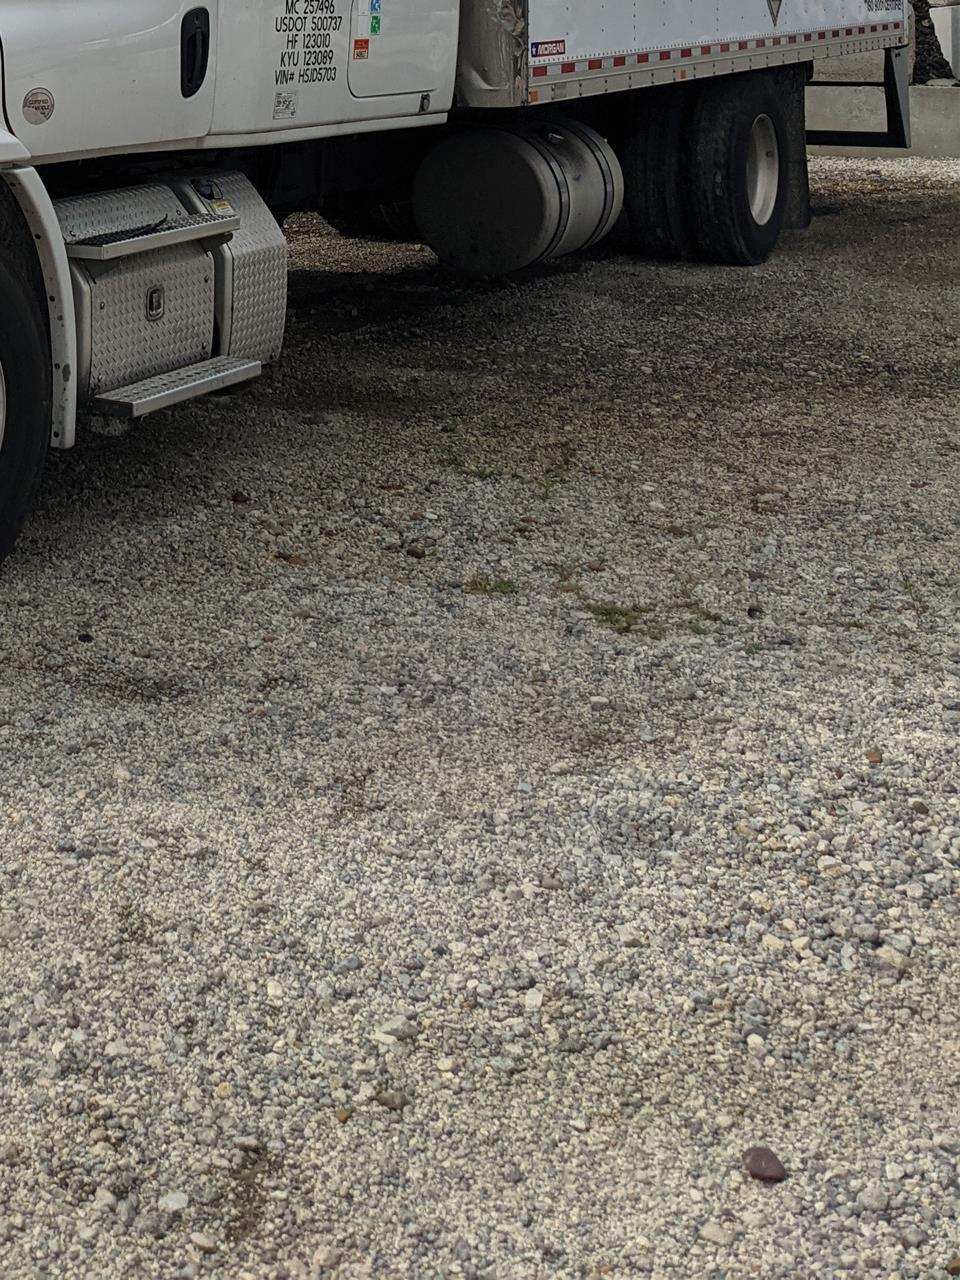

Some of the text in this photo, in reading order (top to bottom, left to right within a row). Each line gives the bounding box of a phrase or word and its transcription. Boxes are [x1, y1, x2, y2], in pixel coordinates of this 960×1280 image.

[285, 0, 300, 15] MC
[275, 15, 343, 33] USDOT 500737
[286, 32, 331, 50] HF 123010
[537, 42, 564, 56] MORGAN
[280, 51, 300, 68] KYU
[303, 49, 334, 67] 123089
[275, 66, 337, 86] VIN# HSJD5703
